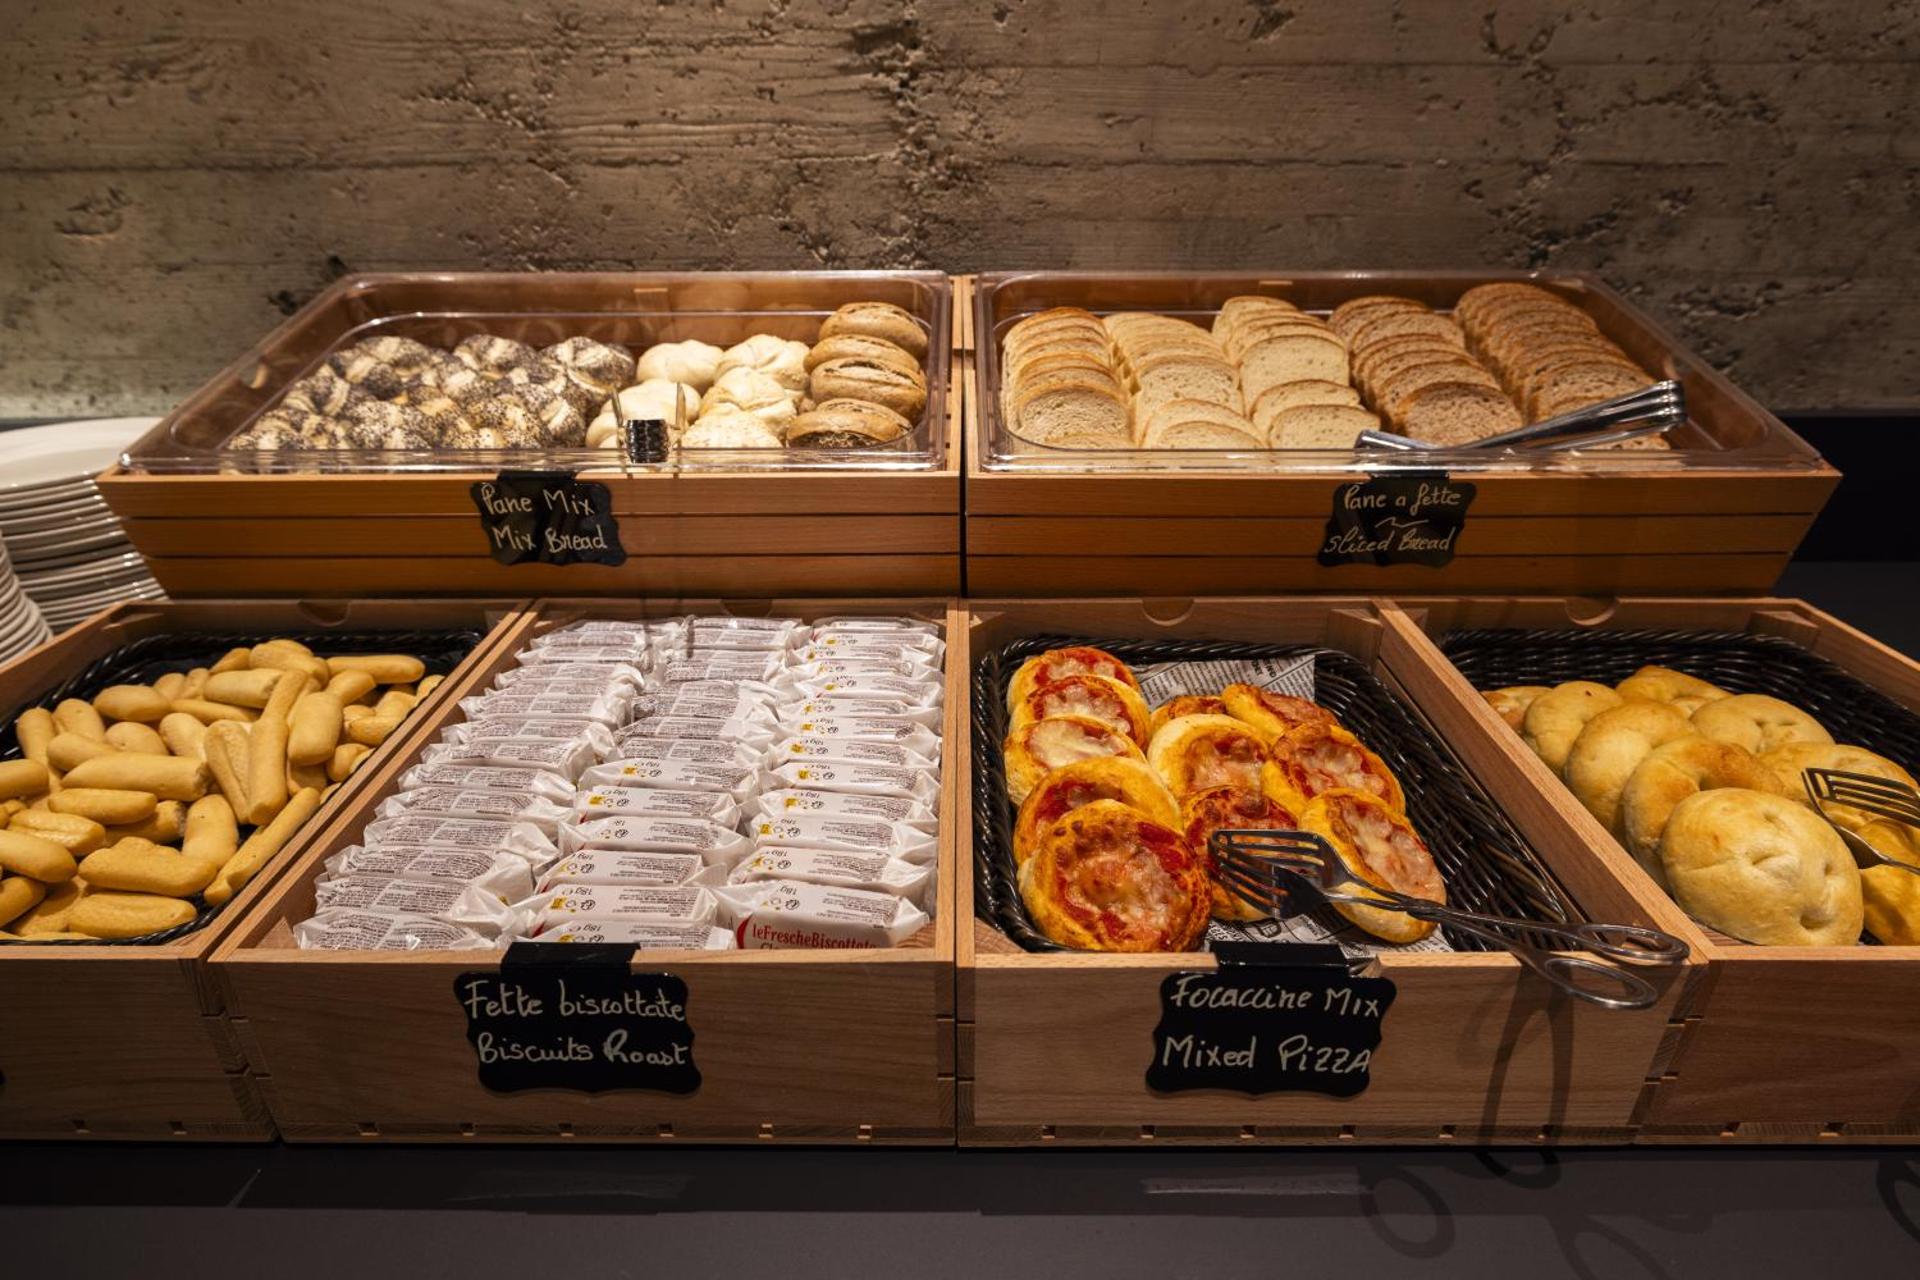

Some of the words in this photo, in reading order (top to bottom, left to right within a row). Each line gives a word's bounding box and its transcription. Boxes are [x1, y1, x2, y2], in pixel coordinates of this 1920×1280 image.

[481, 482, 532, 514] Pane
[543, 489, 595, 515] Mix
[1344, 484, 1387, 510] Pane
[1395, 495, 1406, 507] a
[1409, 483, 1461, 516] fette
[492, 525, 537, 551] Mix
[545, 523, 608, 553] Bread
[463, 979, 544, 1019] Fette
[557, 979, 686, 1022] biscottate
[1170, 974, 1313, 1009] Focaccine
[477, 1031, 593, 1064] Biscuits
[602, 1028, 689, 1066] Roast
[1161, 1034, 1257, 1069] Mixed
